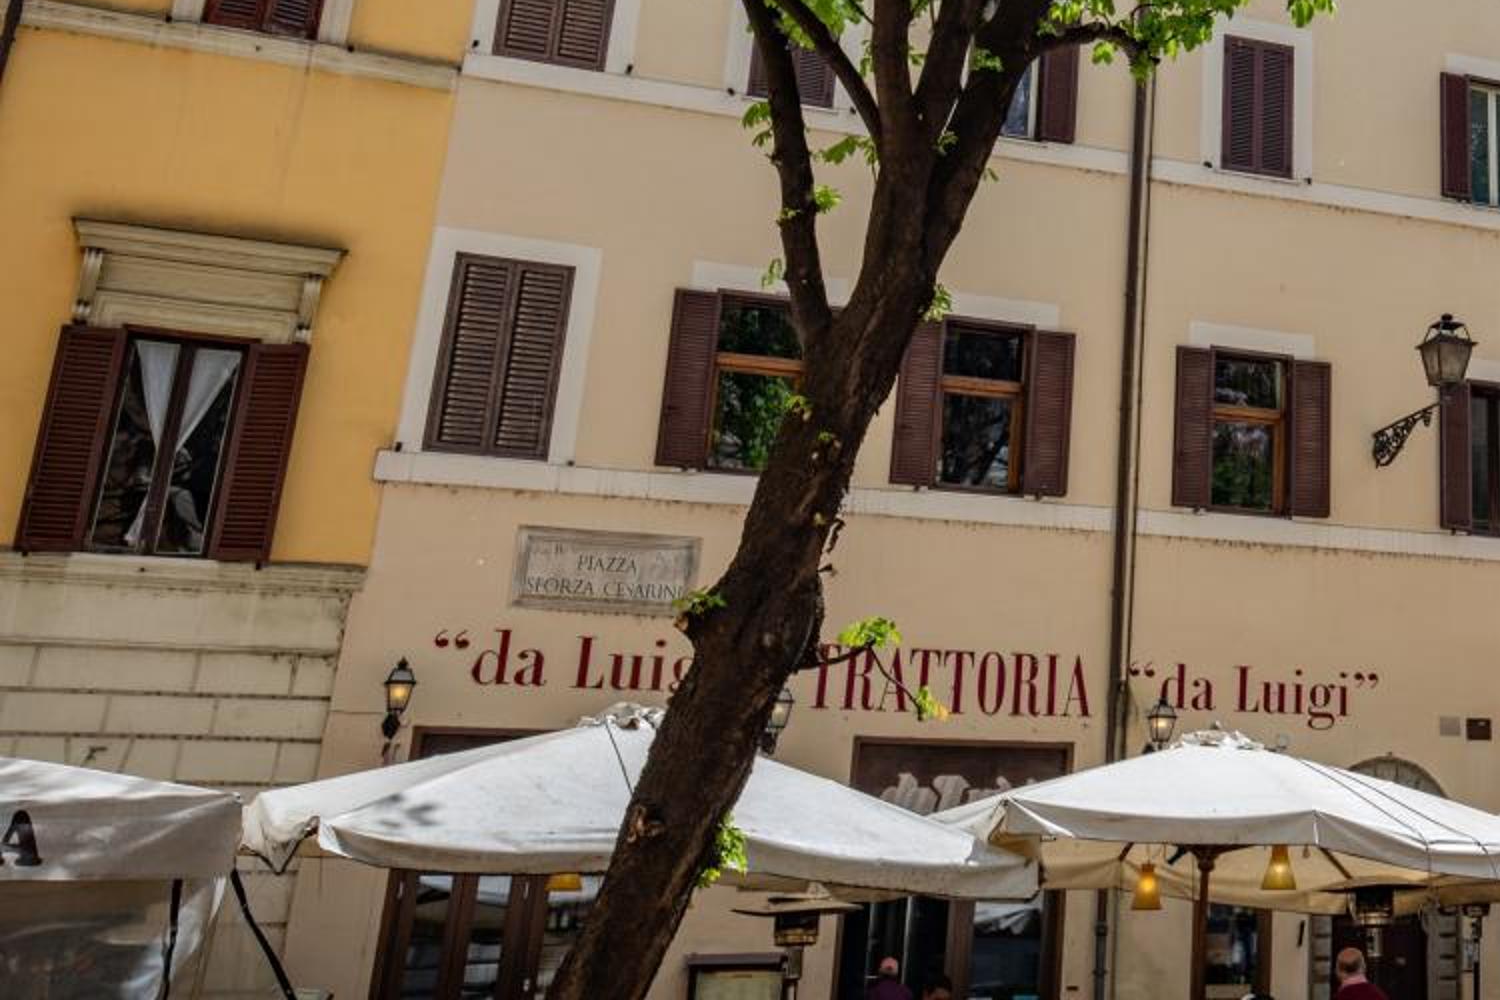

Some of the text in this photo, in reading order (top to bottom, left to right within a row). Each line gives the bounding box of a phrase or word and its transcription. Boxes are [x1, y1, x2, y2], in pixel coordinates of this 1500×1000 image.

[577, 555, 637, 574] PIAZZA
[527, 577, 594, 596] SFORZA
[810, 643, 1093, 718] TRATTORIA
